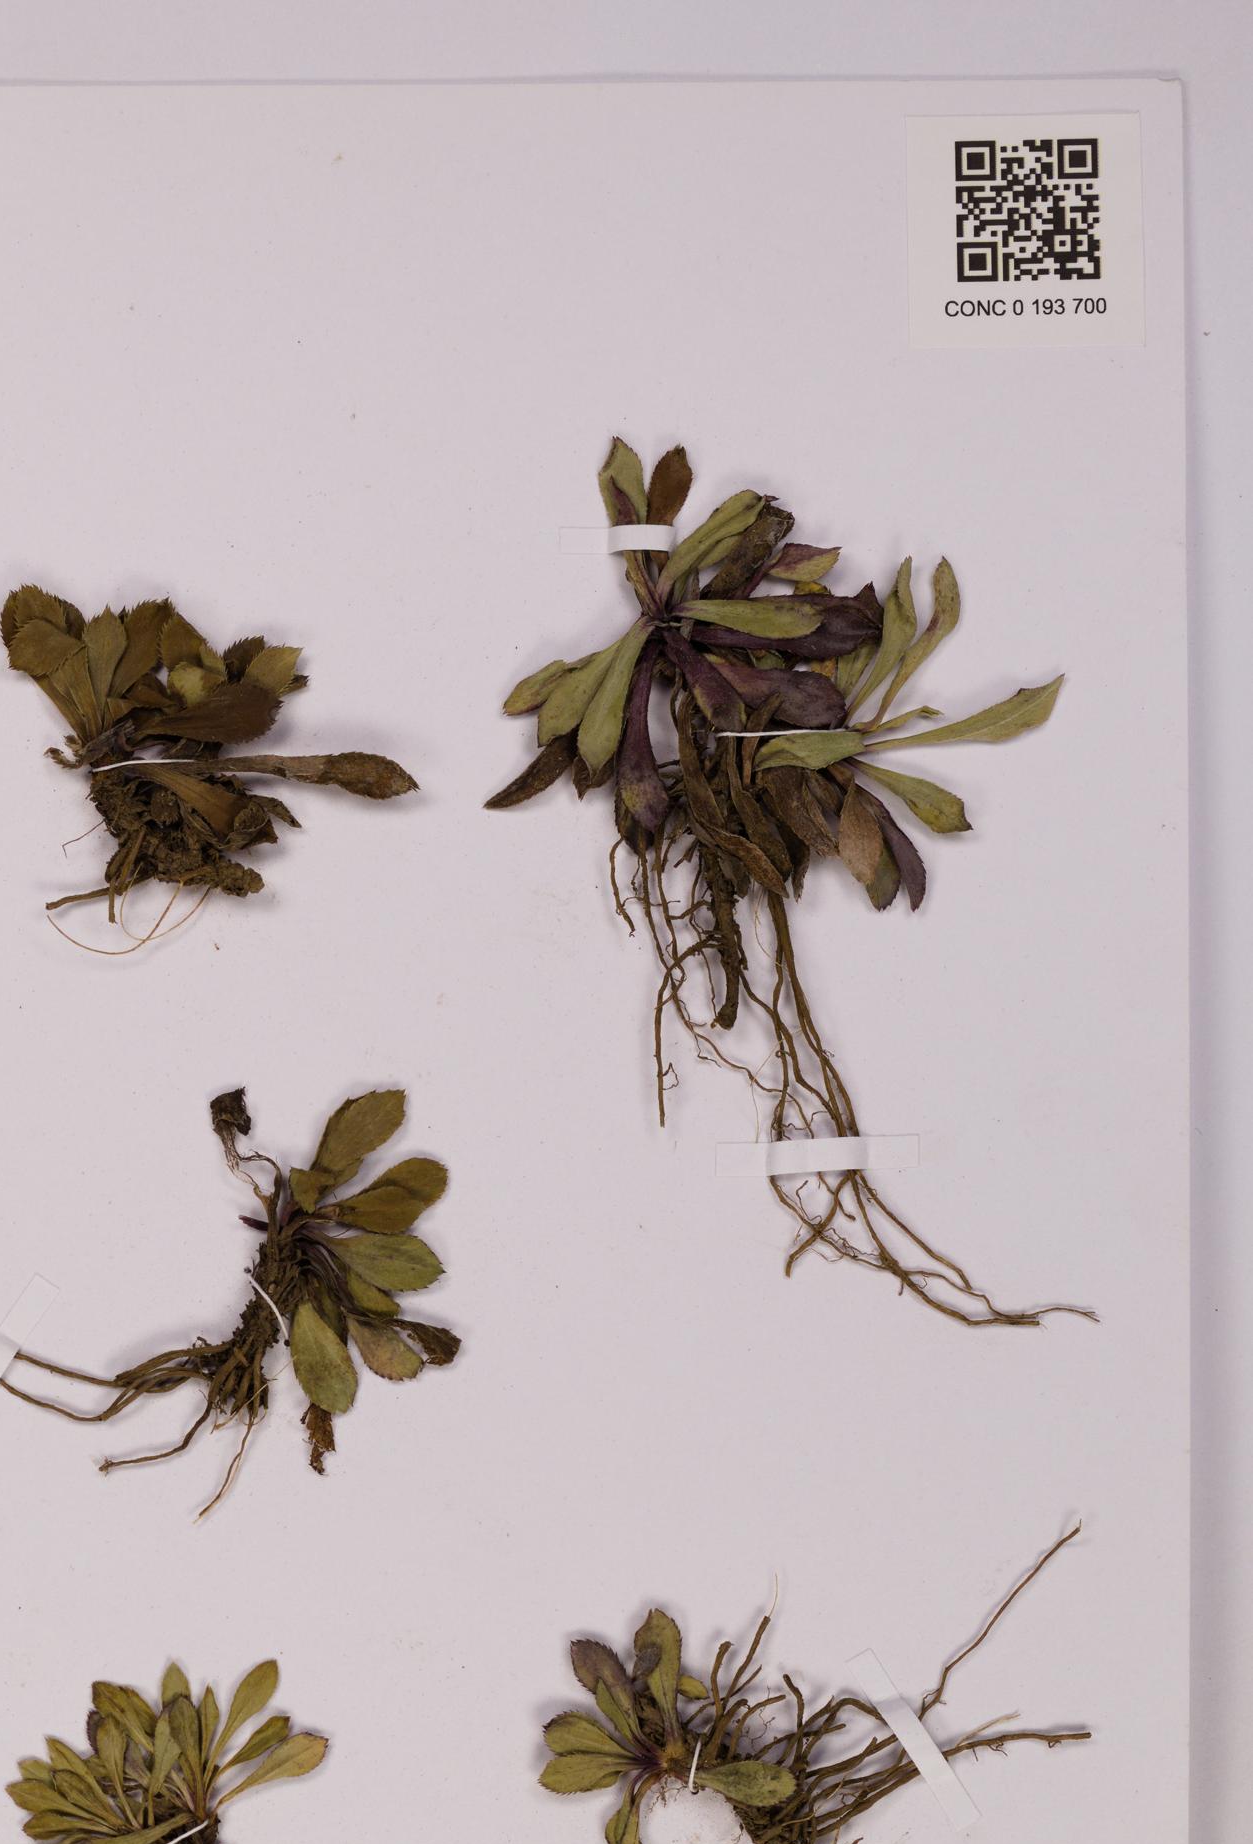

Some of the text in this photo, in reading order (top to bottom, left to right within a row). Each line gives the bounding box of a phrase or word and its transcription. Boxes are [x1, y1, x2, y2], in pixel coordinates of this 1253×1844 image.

[945, 298, 1106, 317] CONC 0 193 700
